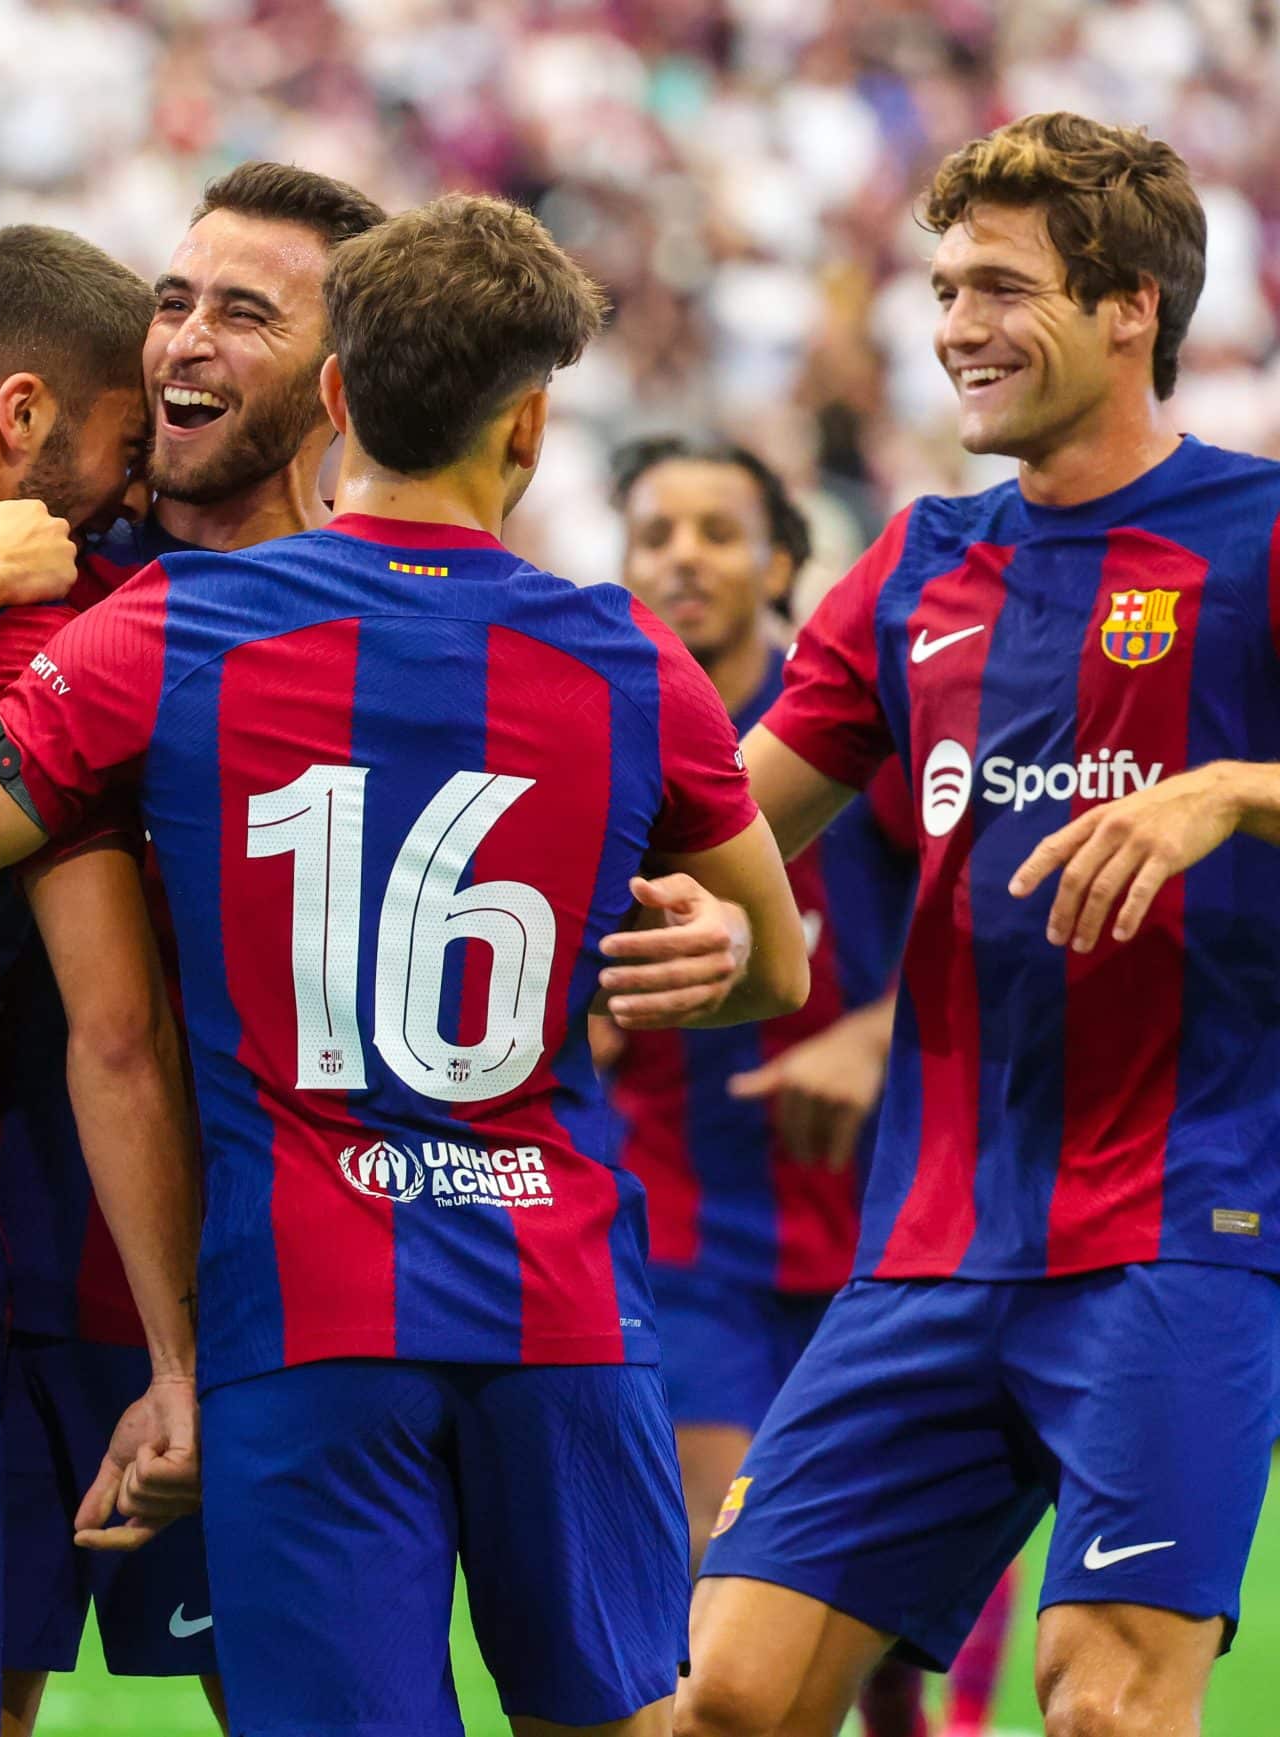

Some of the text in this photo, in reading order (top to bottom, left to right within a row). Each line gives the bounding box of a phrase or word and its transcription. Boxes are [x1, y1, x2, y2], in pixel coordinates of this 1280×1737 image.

[52, 675, 71, 696] tv
[982, 748, 1163, 812] Spotify
[246, 764, 557, 1102] 16
[422, 1142, 545, 1173] UNHCR
[432, 1168, 552, 1197] ACNUR
[435, 1197, 453, 1208] The
[453, 1194, 471, 1206] UN
[514, 1197, 553, 1208] Agency
